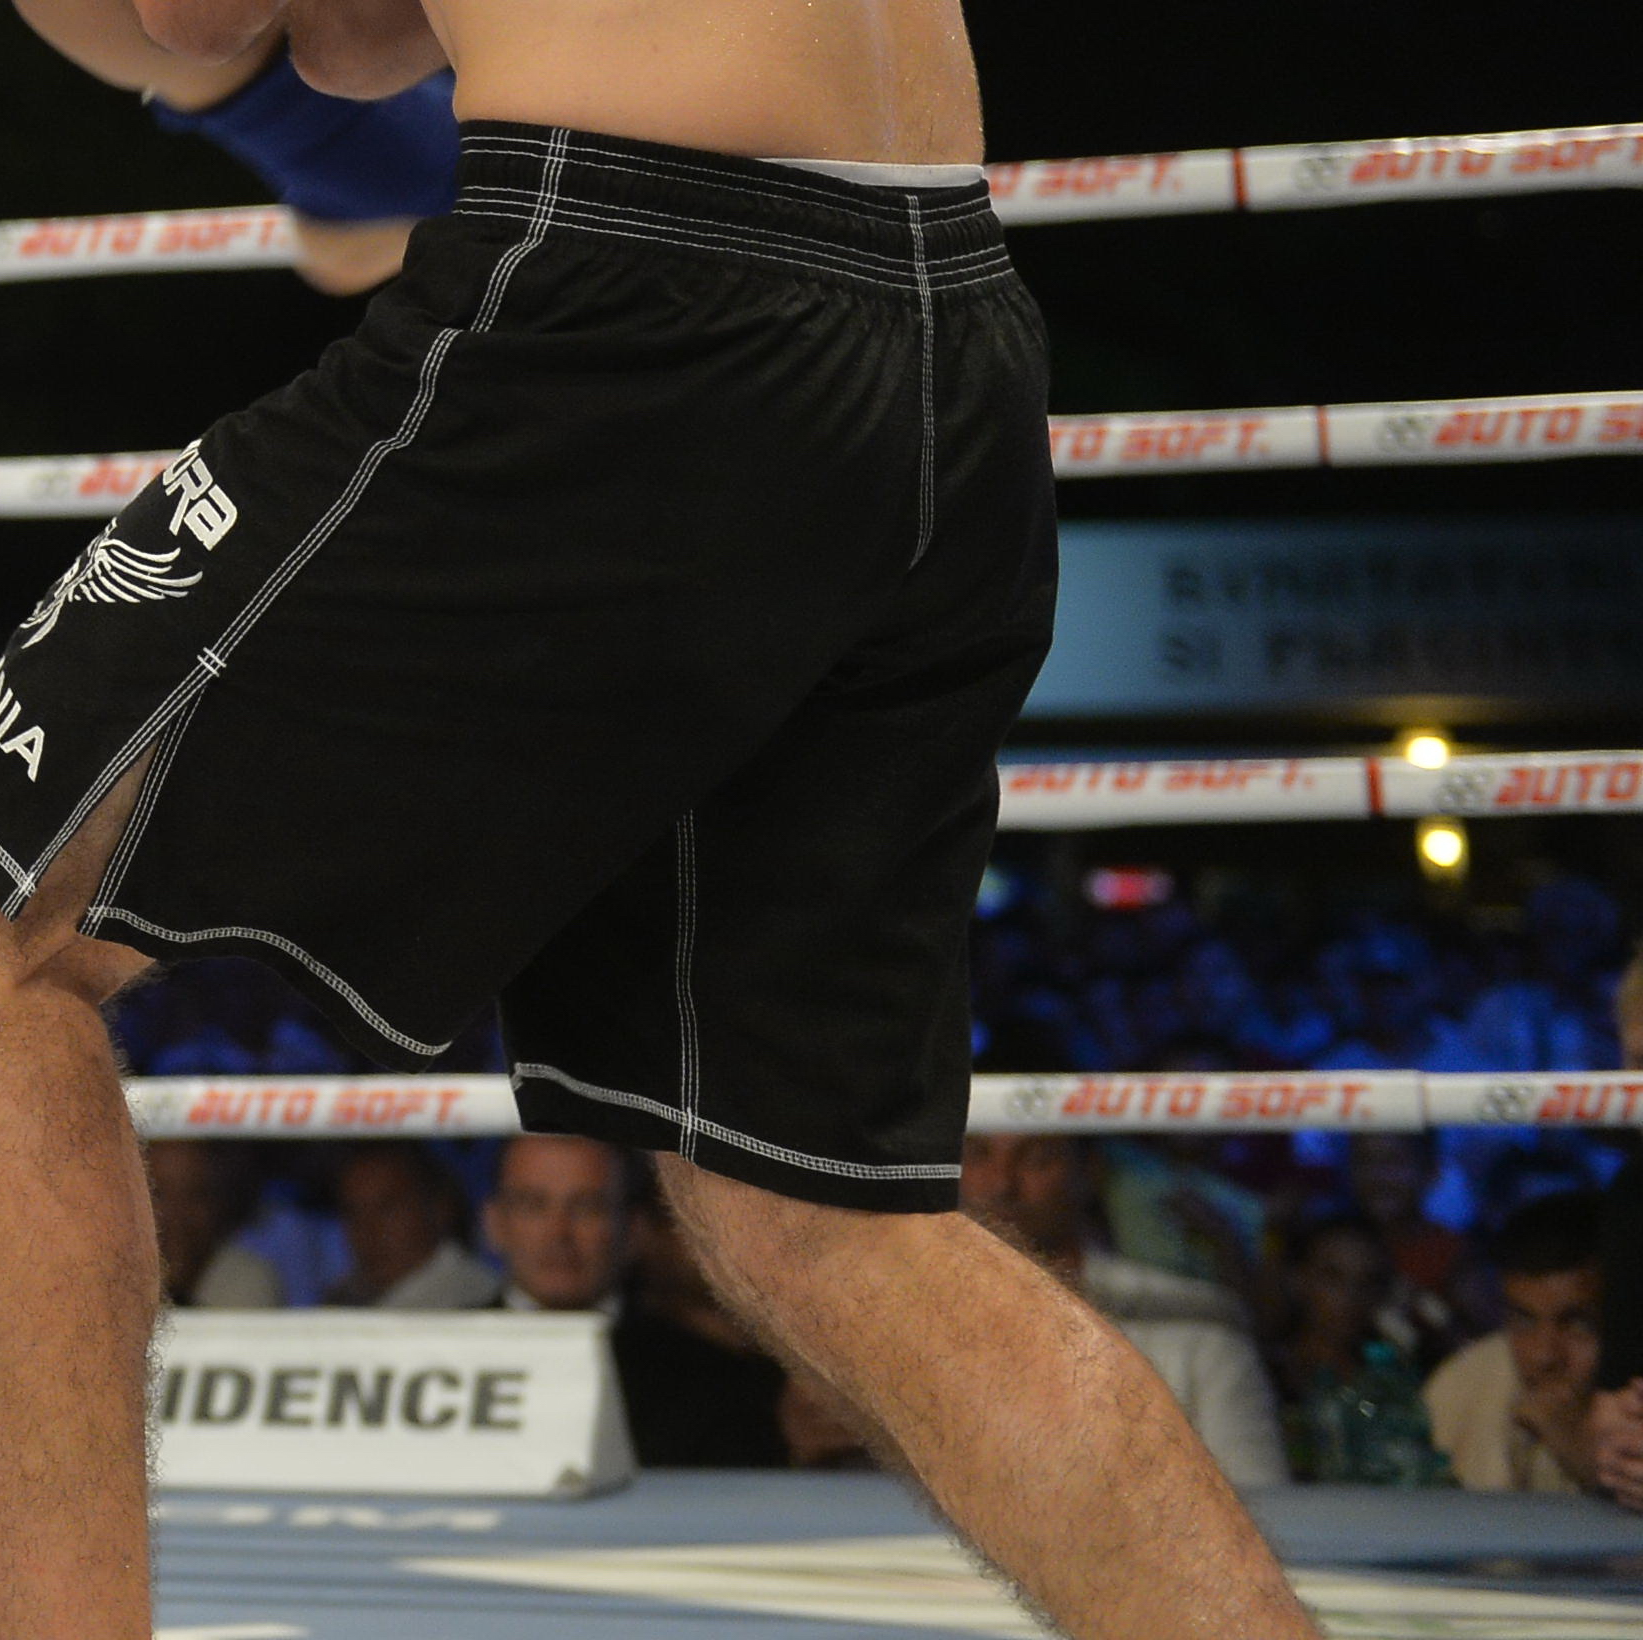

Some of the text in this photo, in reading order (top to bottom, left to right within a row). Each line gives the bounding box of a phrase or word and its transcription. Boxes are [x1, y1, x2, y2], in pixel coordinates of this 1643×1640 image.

[1348, 140, 1497, 185] AUTO
[17, 214, 146, 259] AUTO
[1432, 404, 1587, 448] AUTO
[1493, 760, 1643, 808] AUTO
[186, 1086, 321, 1126] AUTO
[1060, 1076, 1205, 1119] AUTO
